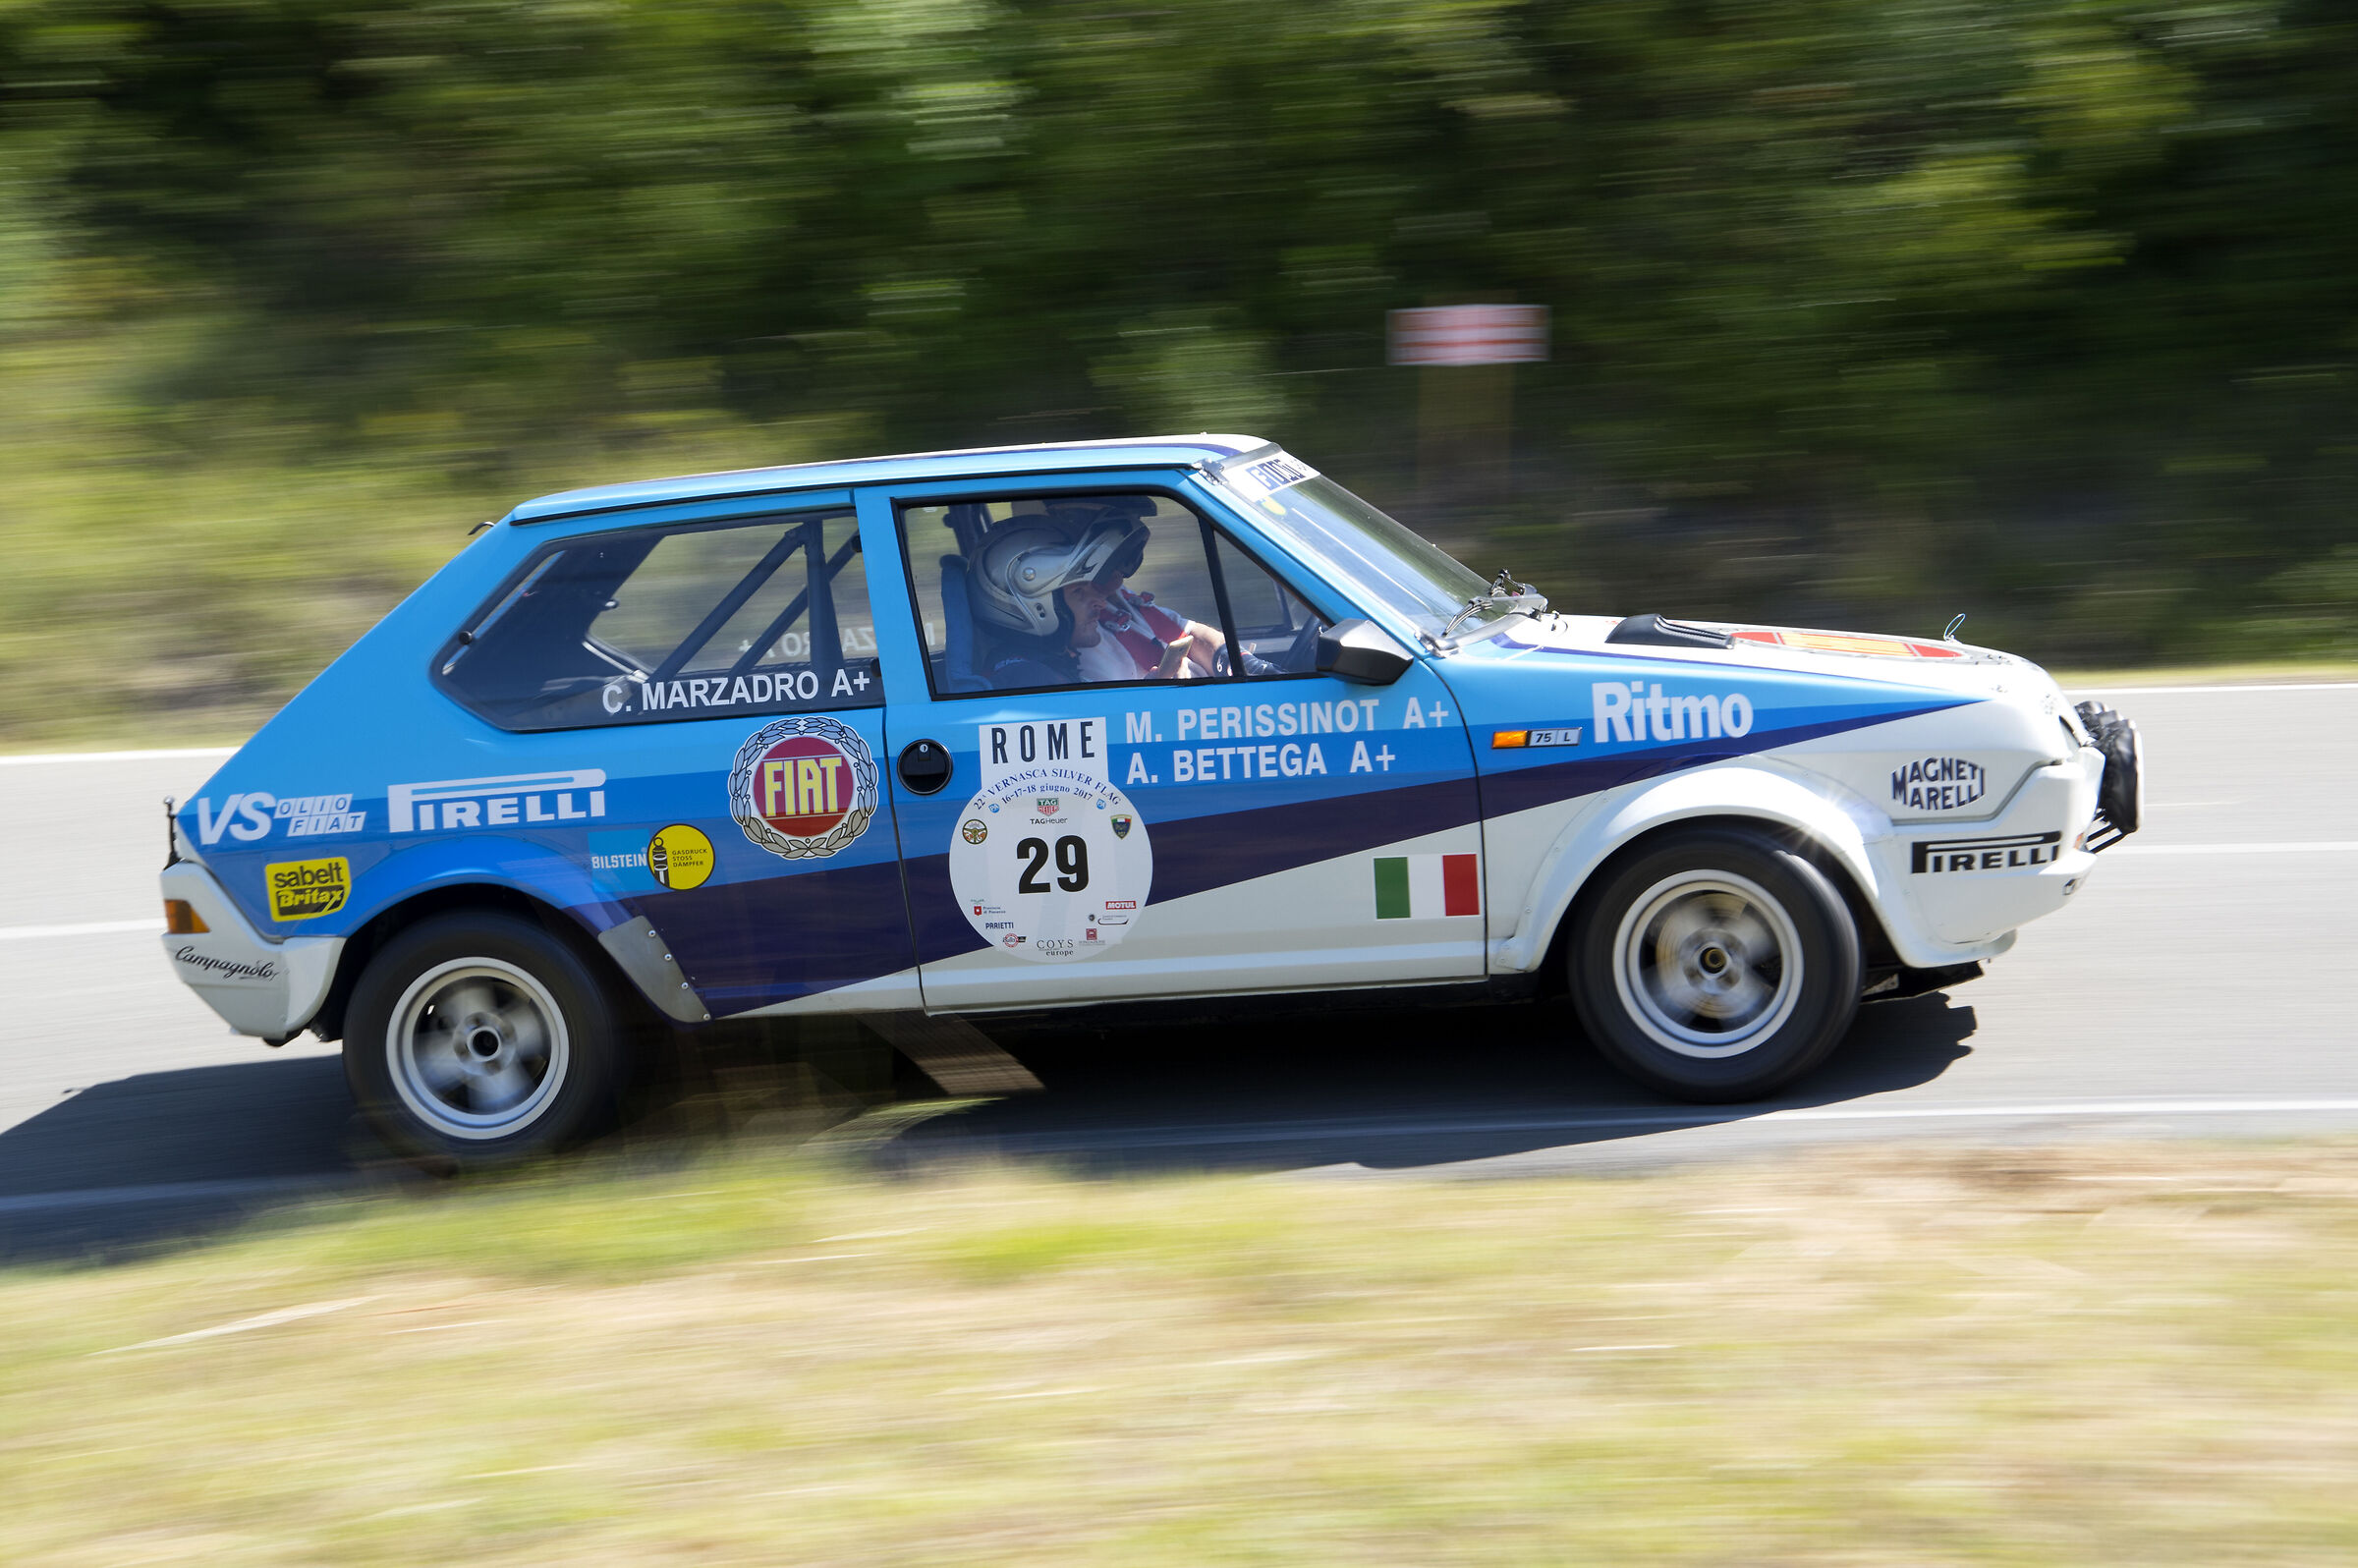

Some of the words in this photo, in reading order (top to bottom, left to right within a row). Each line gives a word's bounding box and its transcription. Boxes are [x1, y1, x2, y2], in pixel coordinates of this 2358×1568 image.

[602, 685, 631, 714] C.
[642, 671, 819, 710] MARZADRO
[831, 669, 870, 698] A+
[1126, 711, 1162, 744] M.
[1177, 699, 1380, 742] PERISSINOT
[1403, 697, 1449, 729] A+
[1592, 681, 1754, 743] Ritmo
[991, 720, 1095, 764] ROME
[1535, 731, 1552, 744] 75
[1562, 730, 1571, 743] L
[1126, 753, 1159, 785] A.
[1173, 743, 1328, 783] BETTEGA
[1350, 740, 1396, 773] A+
[1891, 757, 1985, 791] MAGNETI
[387, 768, 606, 833] PIRELLI
[762, 756, 843, 817] FIAT
[987, 768, 1047, 796] VERNASCA
[1051, 768, 1092, 786] SILVER
[1095, 783, 1121, 806] FLAG
[1001, 783, 1037, 804] 16-17-18
[1039, 783, 1070, 794] giugno
[1074, 787, 1093, 802] 2017
[1891, 776, 1985, 810] MARELLI
[197, 792, 275, 845] VS
[280, 797, 347, 815] OLIO
[293, 815, 362, 833] FIAT
[591, 854, 646, 868] BILSTEIN
[1016, 835, 1090, 894] 29
[1912, 831, 2060, 874] PIRELLI
[274, 864, 344, 889] sabelt
[277, 884, 345, 908] Britax
[176, 944, 278, 980] Campagnolo
[1037, 939, 1075, 950] COYS
